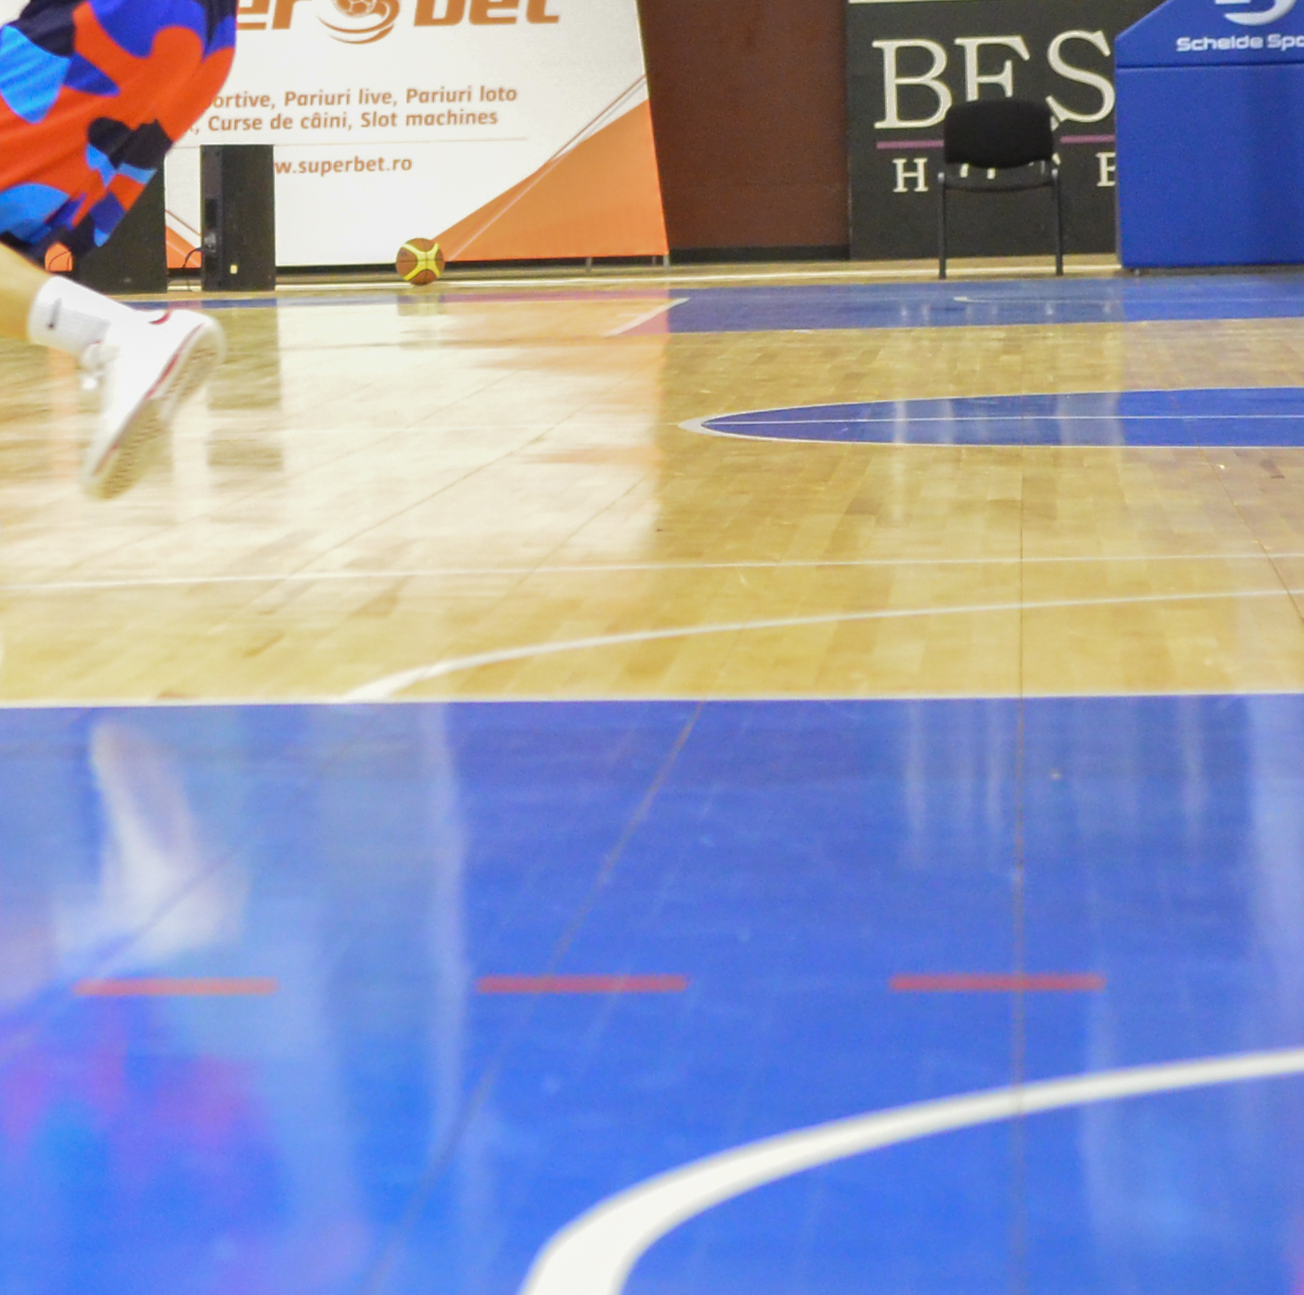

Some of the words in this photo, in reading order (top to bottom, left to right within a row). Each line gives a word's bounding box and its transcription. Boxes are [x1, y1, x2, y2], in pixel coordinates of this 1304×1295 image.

[1176, 36, 1264, 52] Schelde
[284, 89, 351, 107] Pariuri
[358, 88, 398, 108] live,
[406, 86, 472, 104] Pariuri
[480, 85, 518, 102] loto
[208, 115, 263, 132] Curse
[270, 113, 293, 130] de
[360, 111, 399, 128] Slot
[406, 109, 498, 126] machines
